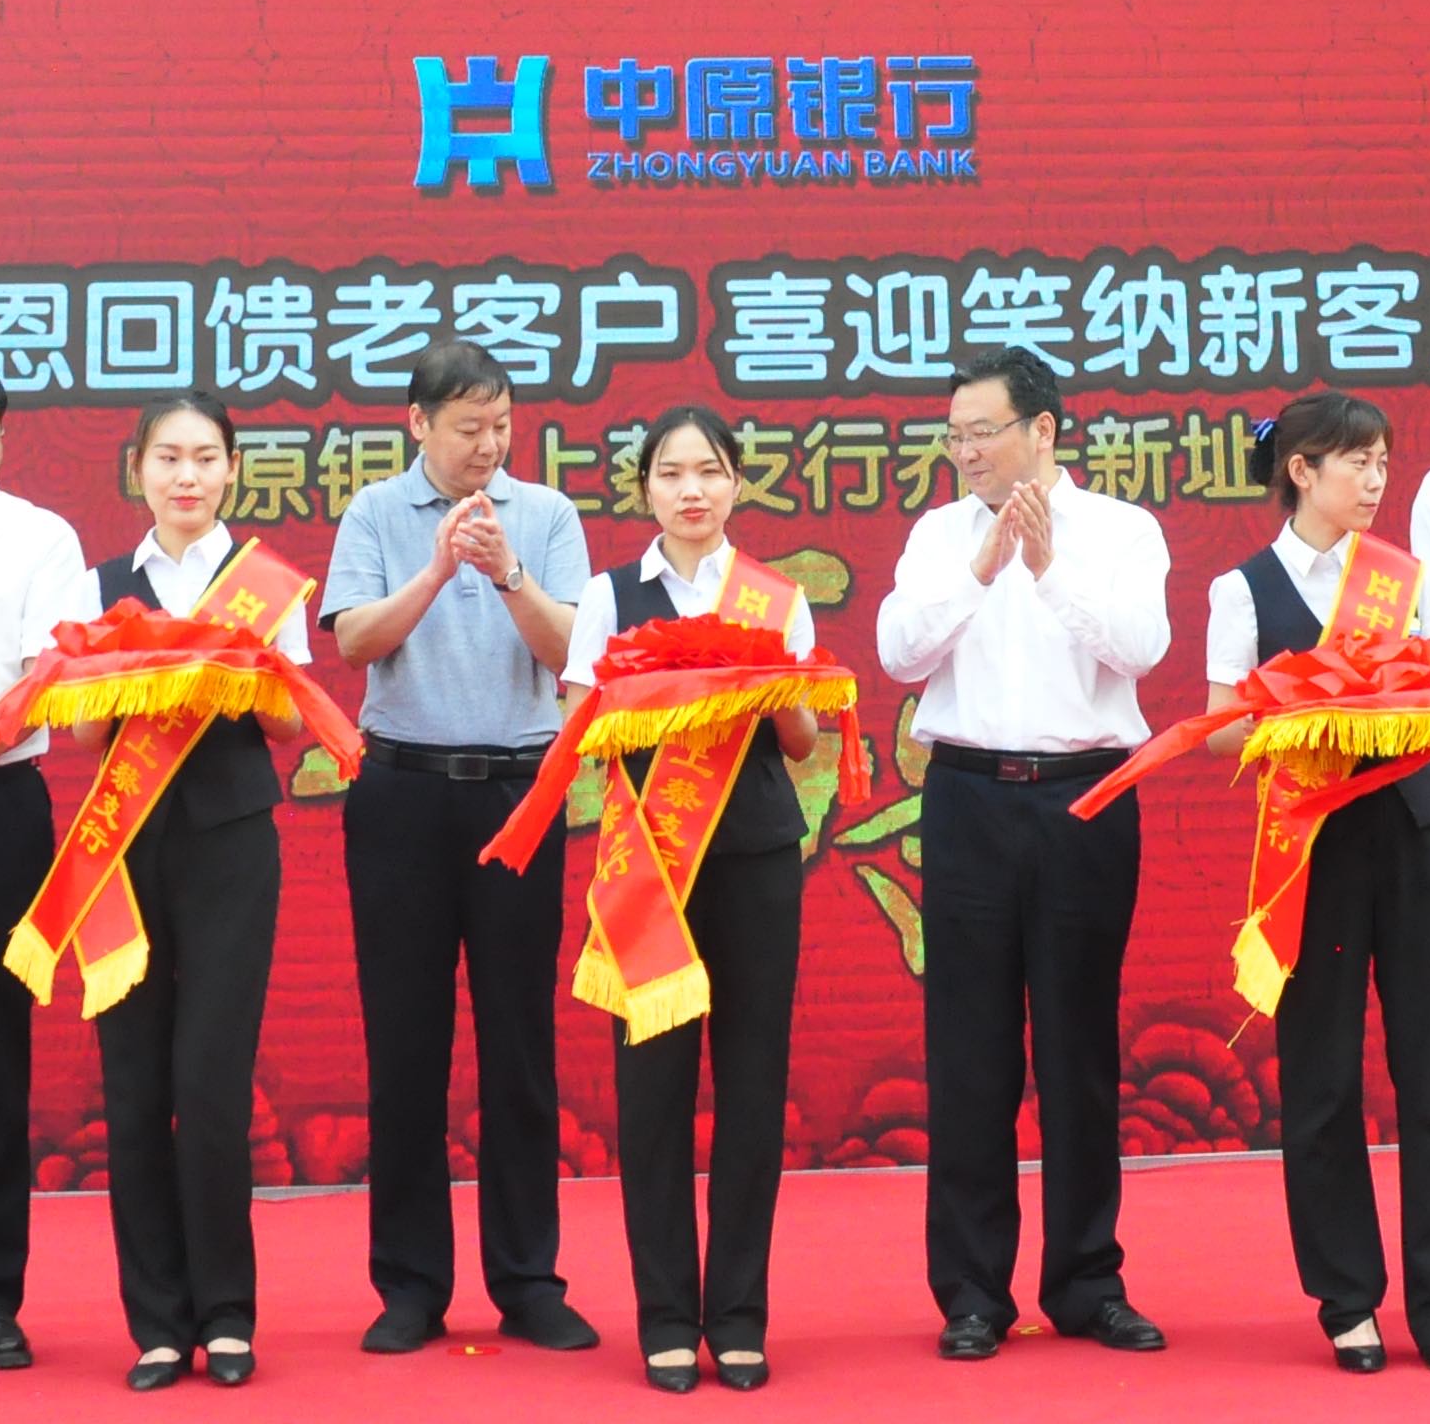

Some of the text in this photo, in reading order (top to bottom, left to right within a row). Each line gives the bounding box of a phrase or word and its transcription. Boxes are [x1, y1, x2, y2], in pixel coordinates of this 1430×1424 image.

[584, 55, 975, 140] 中原银行
[587, 148, 977, 181] ZHONGYUAN BANK
